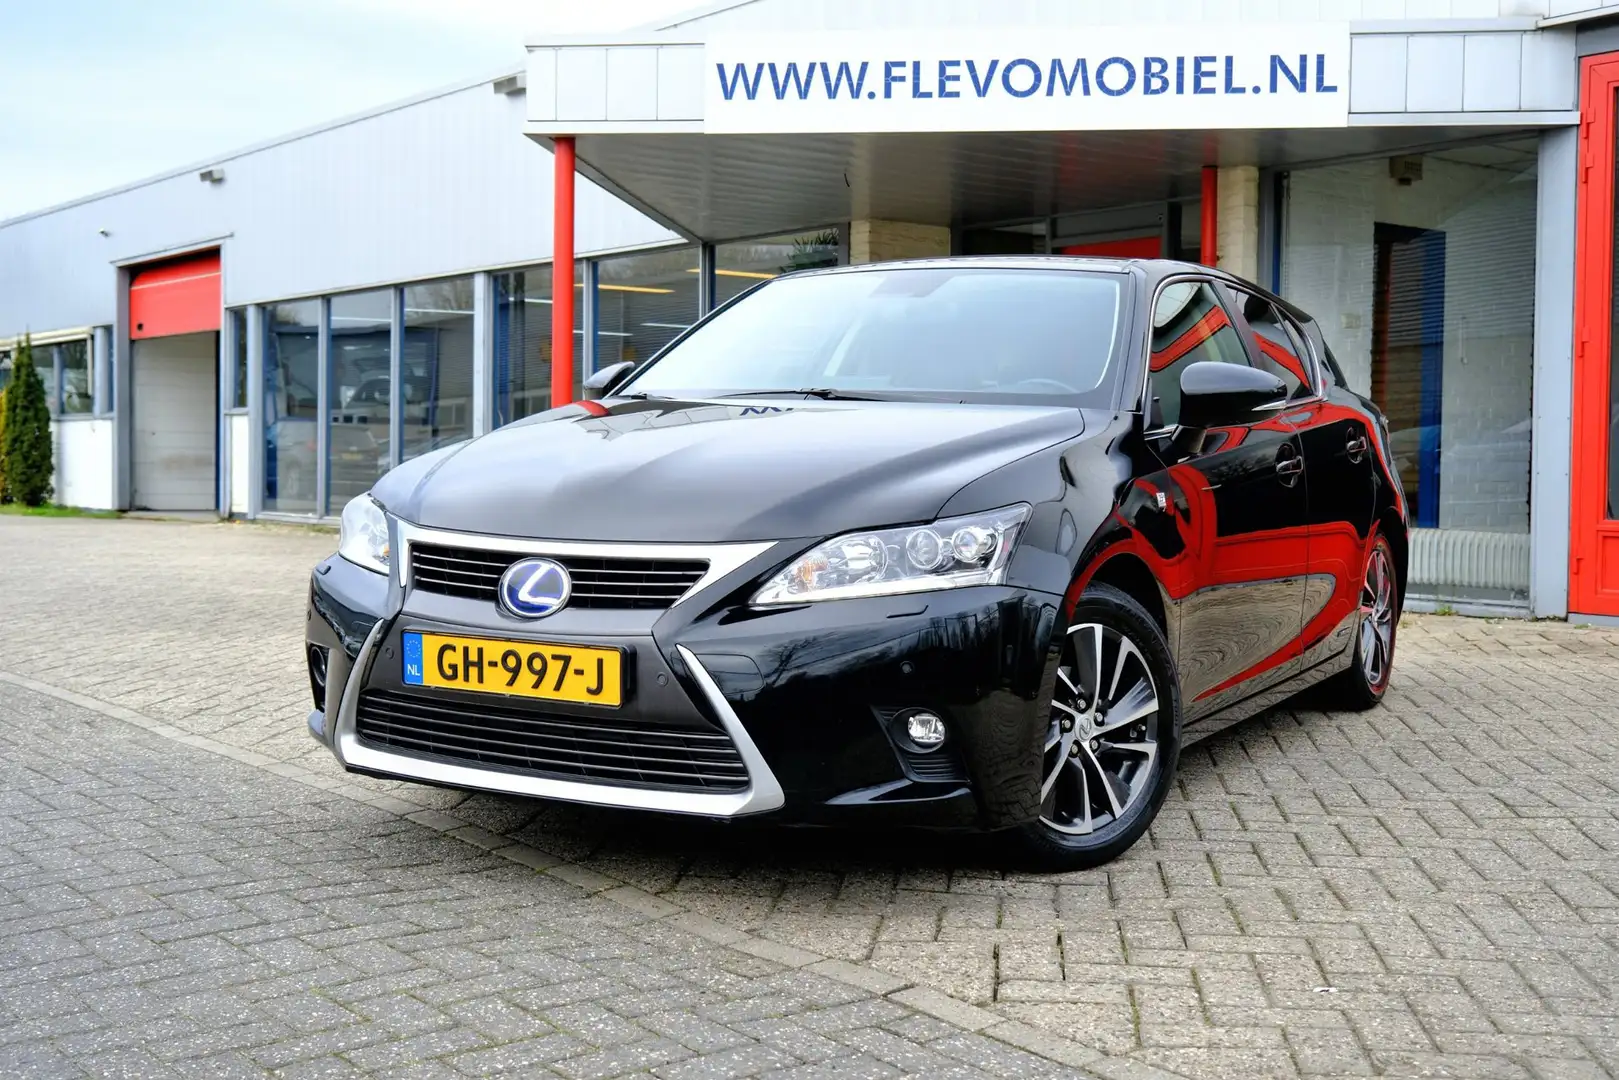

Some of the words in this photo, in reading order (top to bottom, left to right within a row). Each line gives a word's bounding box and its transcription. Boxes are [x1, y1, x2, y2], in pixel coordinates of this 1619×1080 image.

[716, 54, 1338, 100] WWW.FLEVOMOBIEL.NL
[407, 663, 420, 676] NL
[436, 643, 604, 696] GH-997-J
